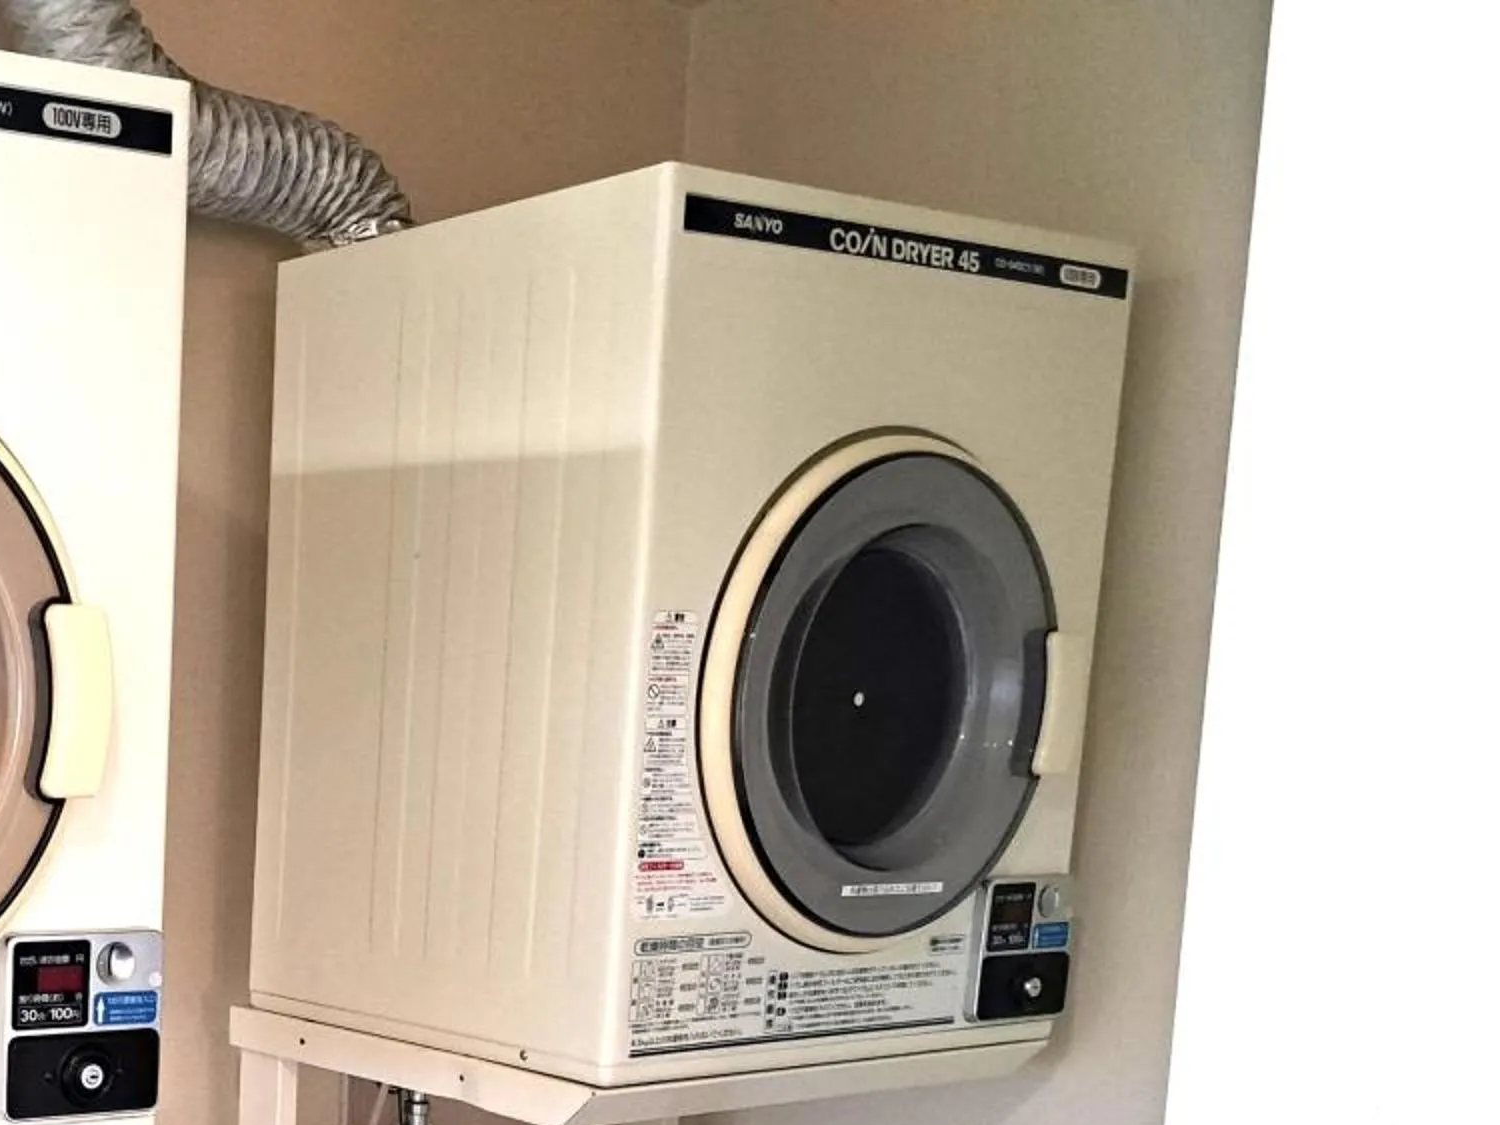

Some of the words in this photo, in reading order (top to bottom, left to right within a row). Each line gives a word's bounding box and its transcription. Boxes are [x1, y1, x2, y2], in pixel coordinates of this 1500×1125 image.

[734, 212, 783, 235] SANYO
[892, 239, 954, 270] DRYER
[957, 250, 981, 273] 45
